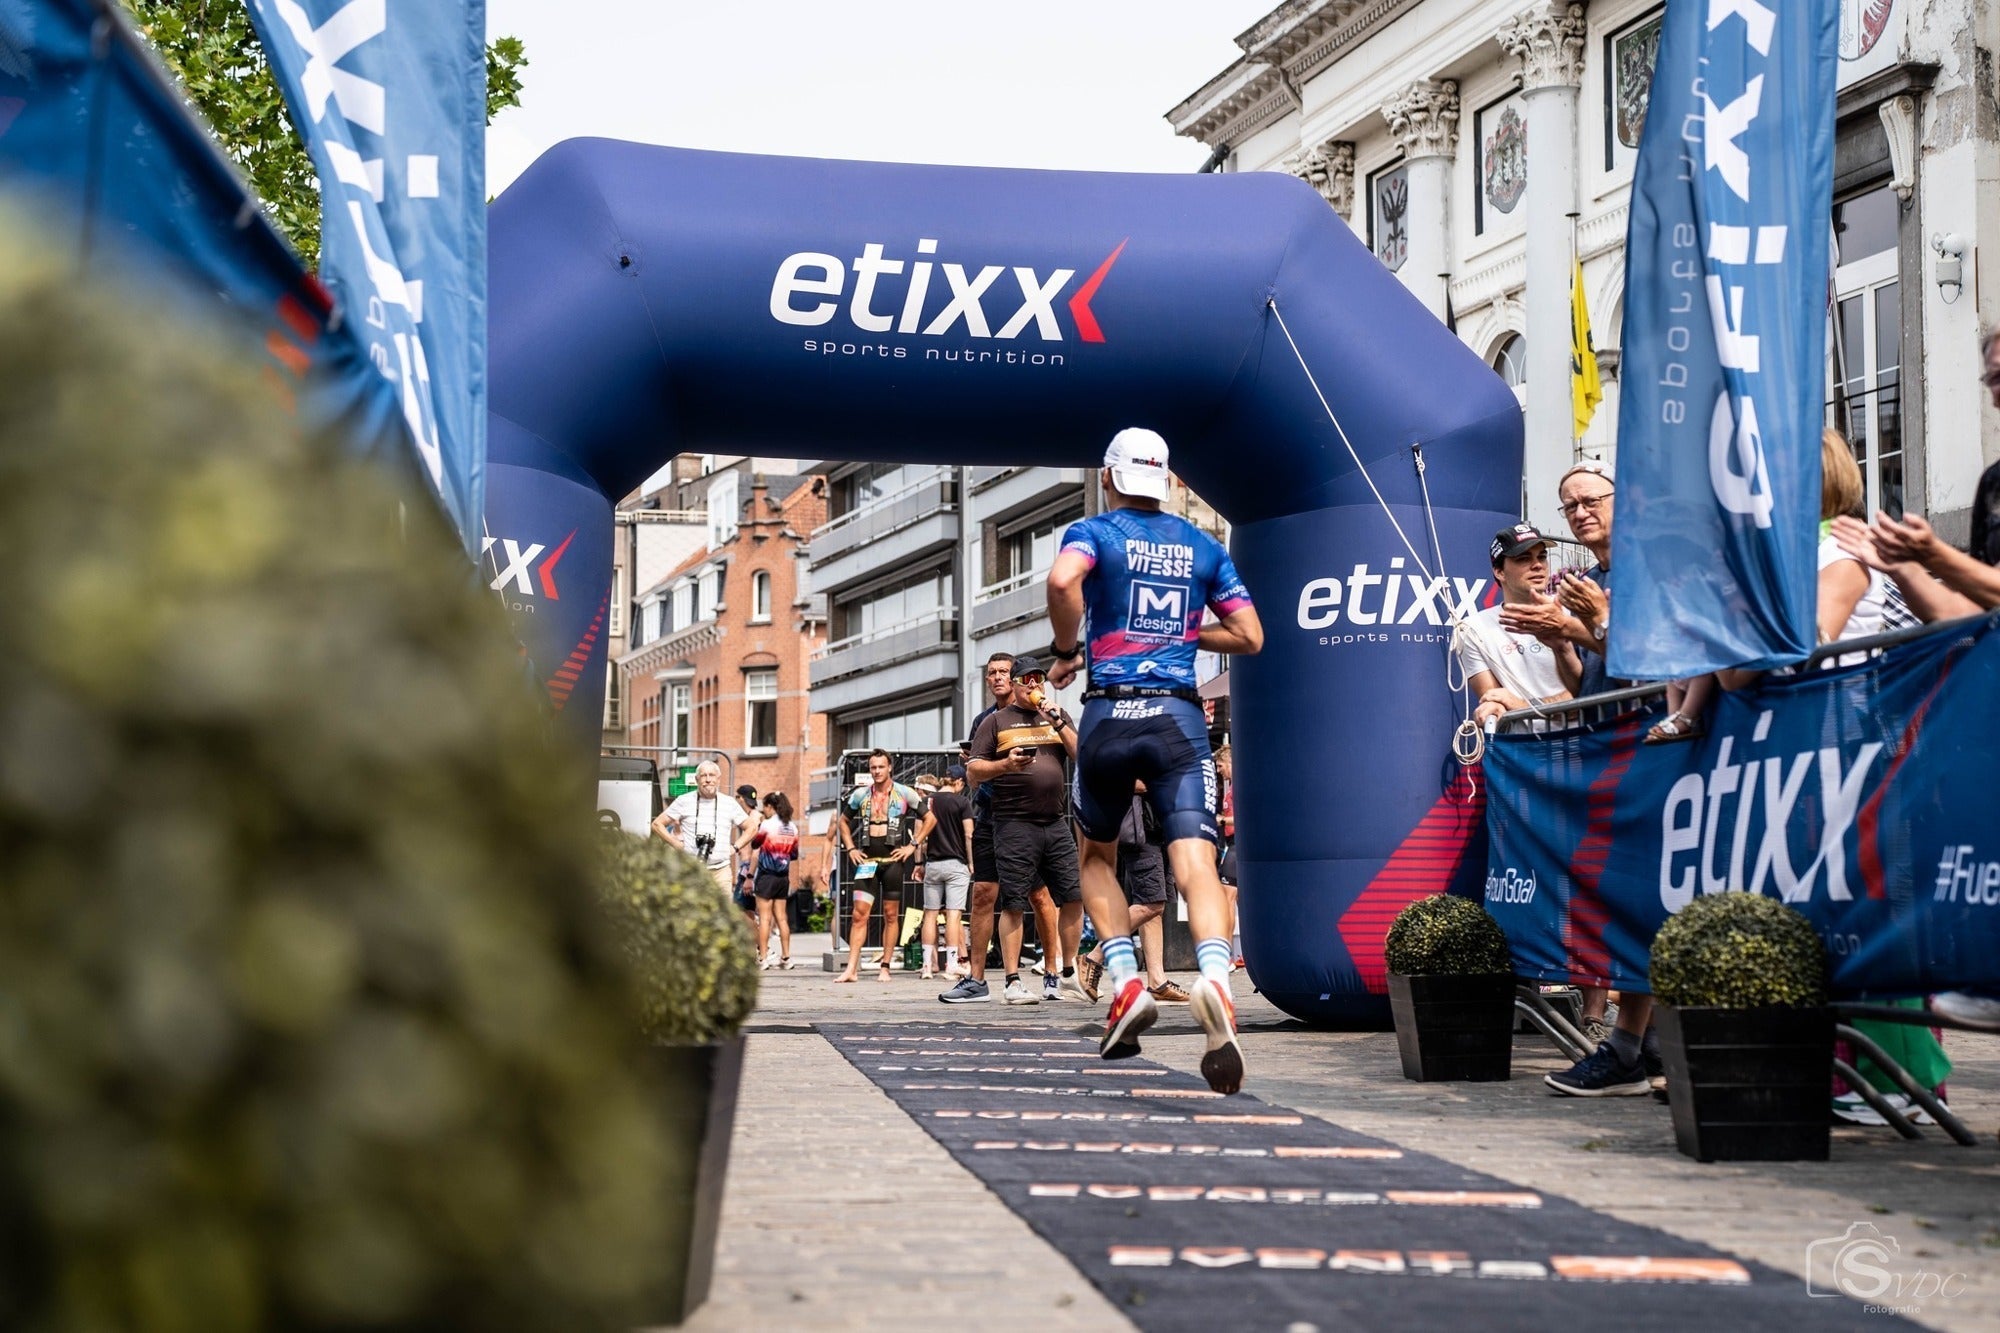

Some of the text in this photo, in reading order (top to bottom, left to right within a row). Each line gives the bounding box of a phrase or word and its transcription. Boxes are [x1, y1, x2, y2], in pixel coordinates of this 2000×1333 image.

[769, 238, 1076, 342] etixx
[804, 339, 1065, 366] sports nutrition
[1125, 539, 1194, 561] PULLETON
[1126, 553, 1193, 578] VITESSE
[1137, 586, 1182, 619] M
[1297, 557, 1487, 630] etixx
[1133, 614, 1183, 635] design
[1319, 632, 1389, 645] sports
[1111, 705, 1164, 719] VITESSE
[1660, 709, 1884, 914] etixx
